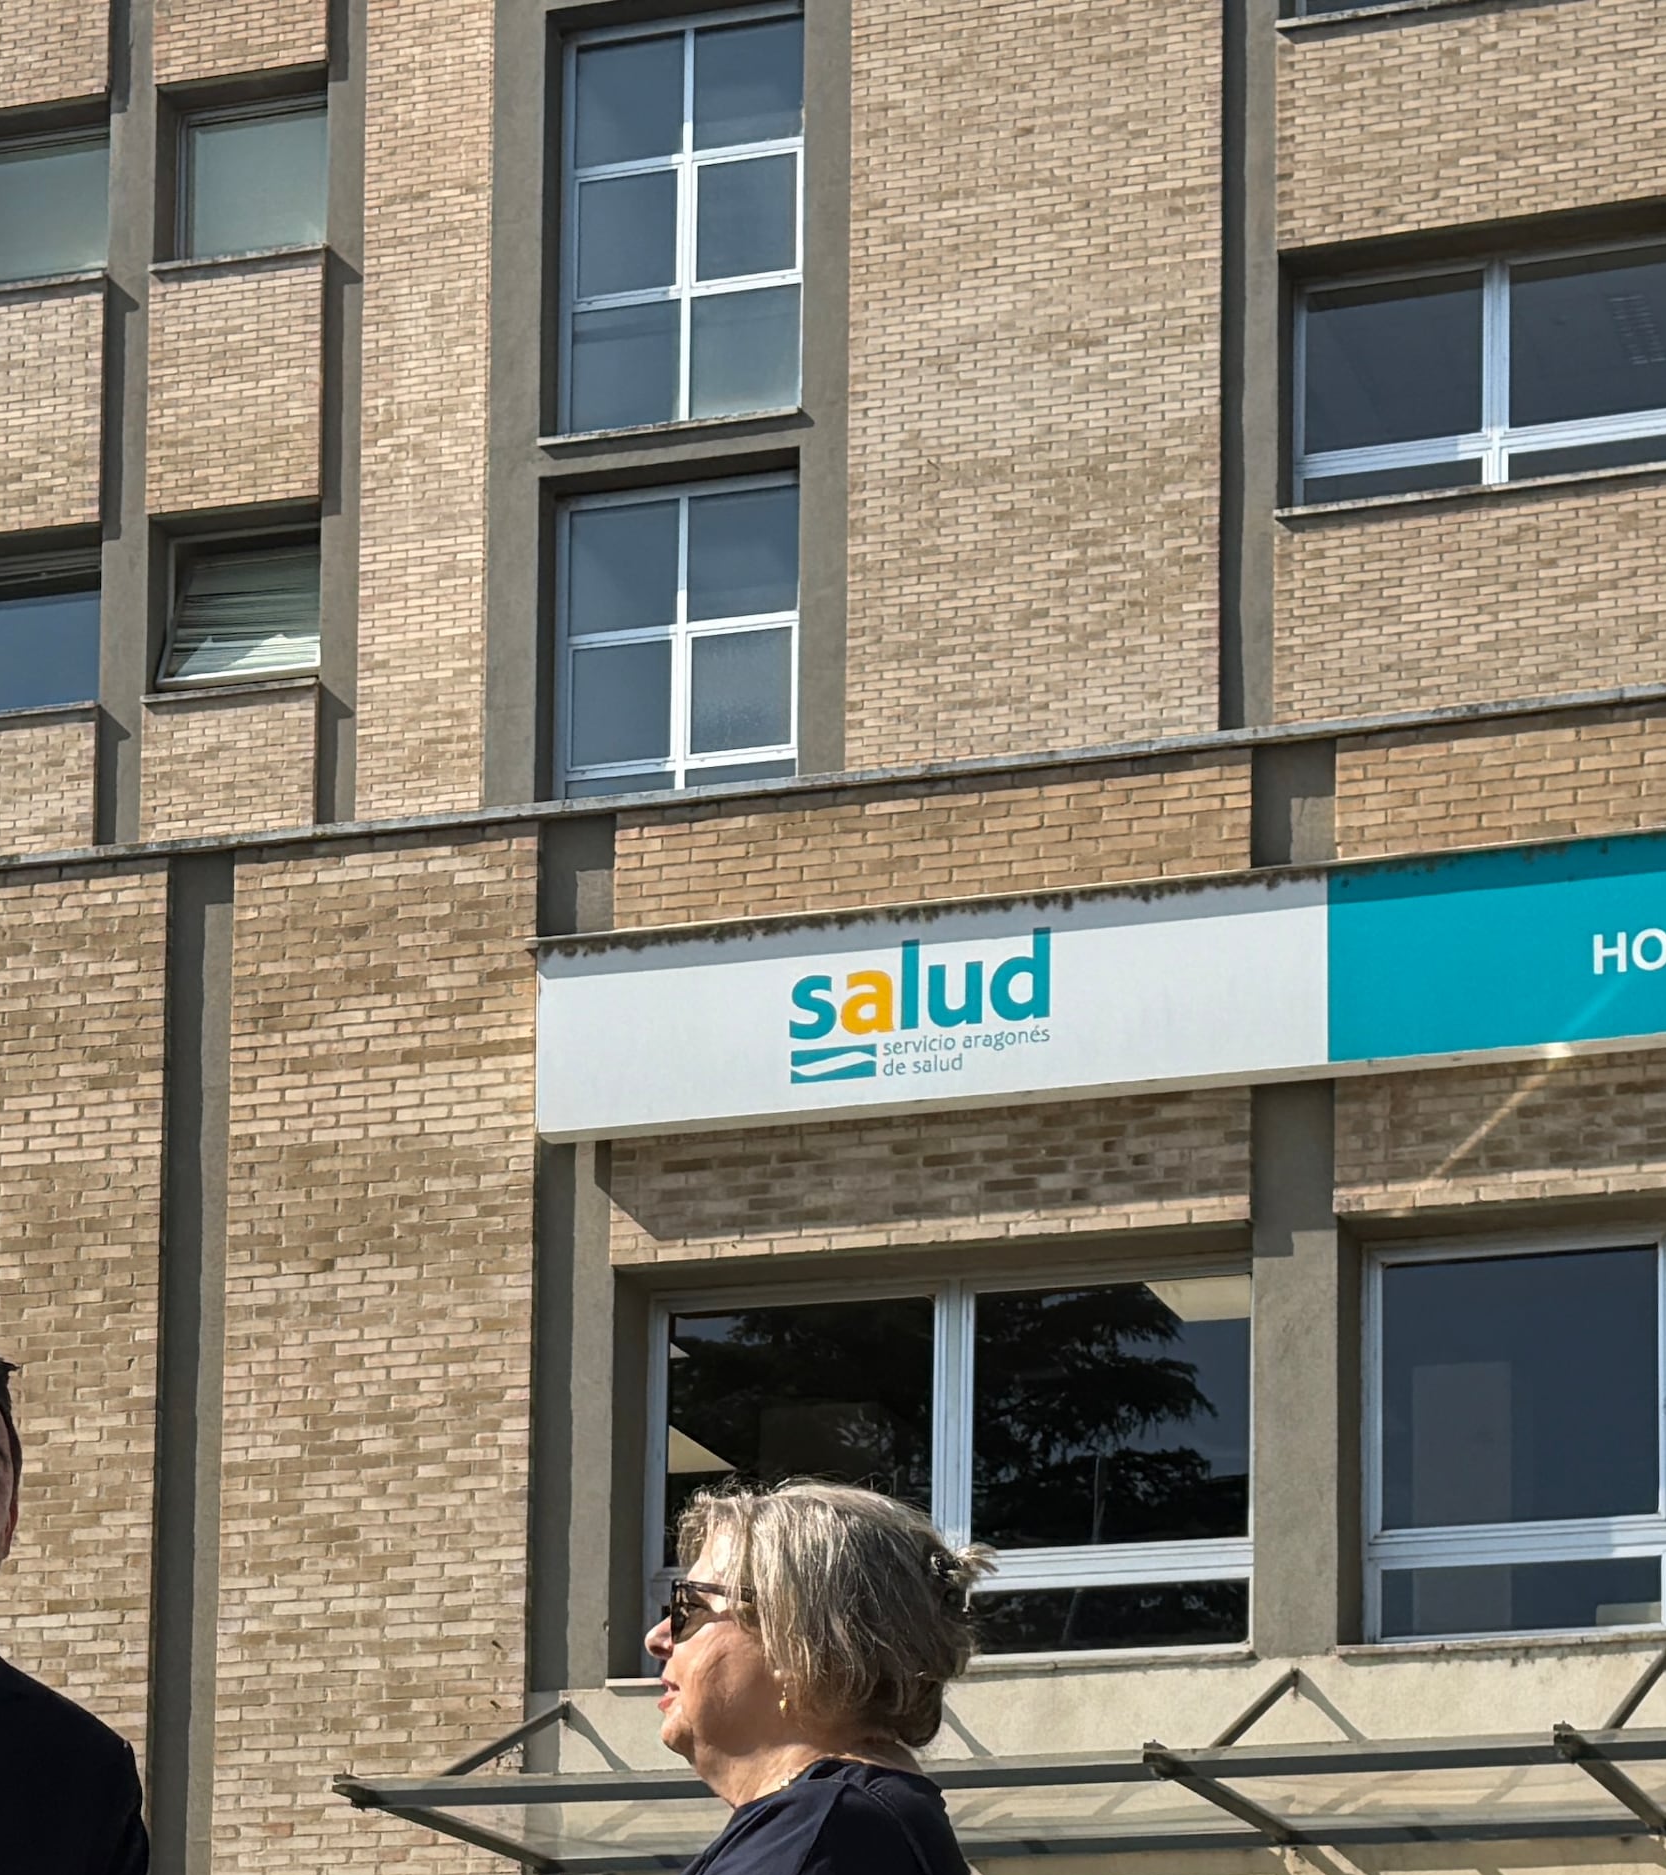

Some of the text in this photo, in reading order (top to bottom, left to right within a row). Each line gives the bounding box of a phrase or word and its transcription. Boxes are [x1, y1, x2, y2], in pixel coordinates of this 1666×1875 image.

[789, 926, 1051, 1040] salud
[882, 1026, 1050, 1056] servicio aragonés
[882, 1053, 963, 1076] de salud
